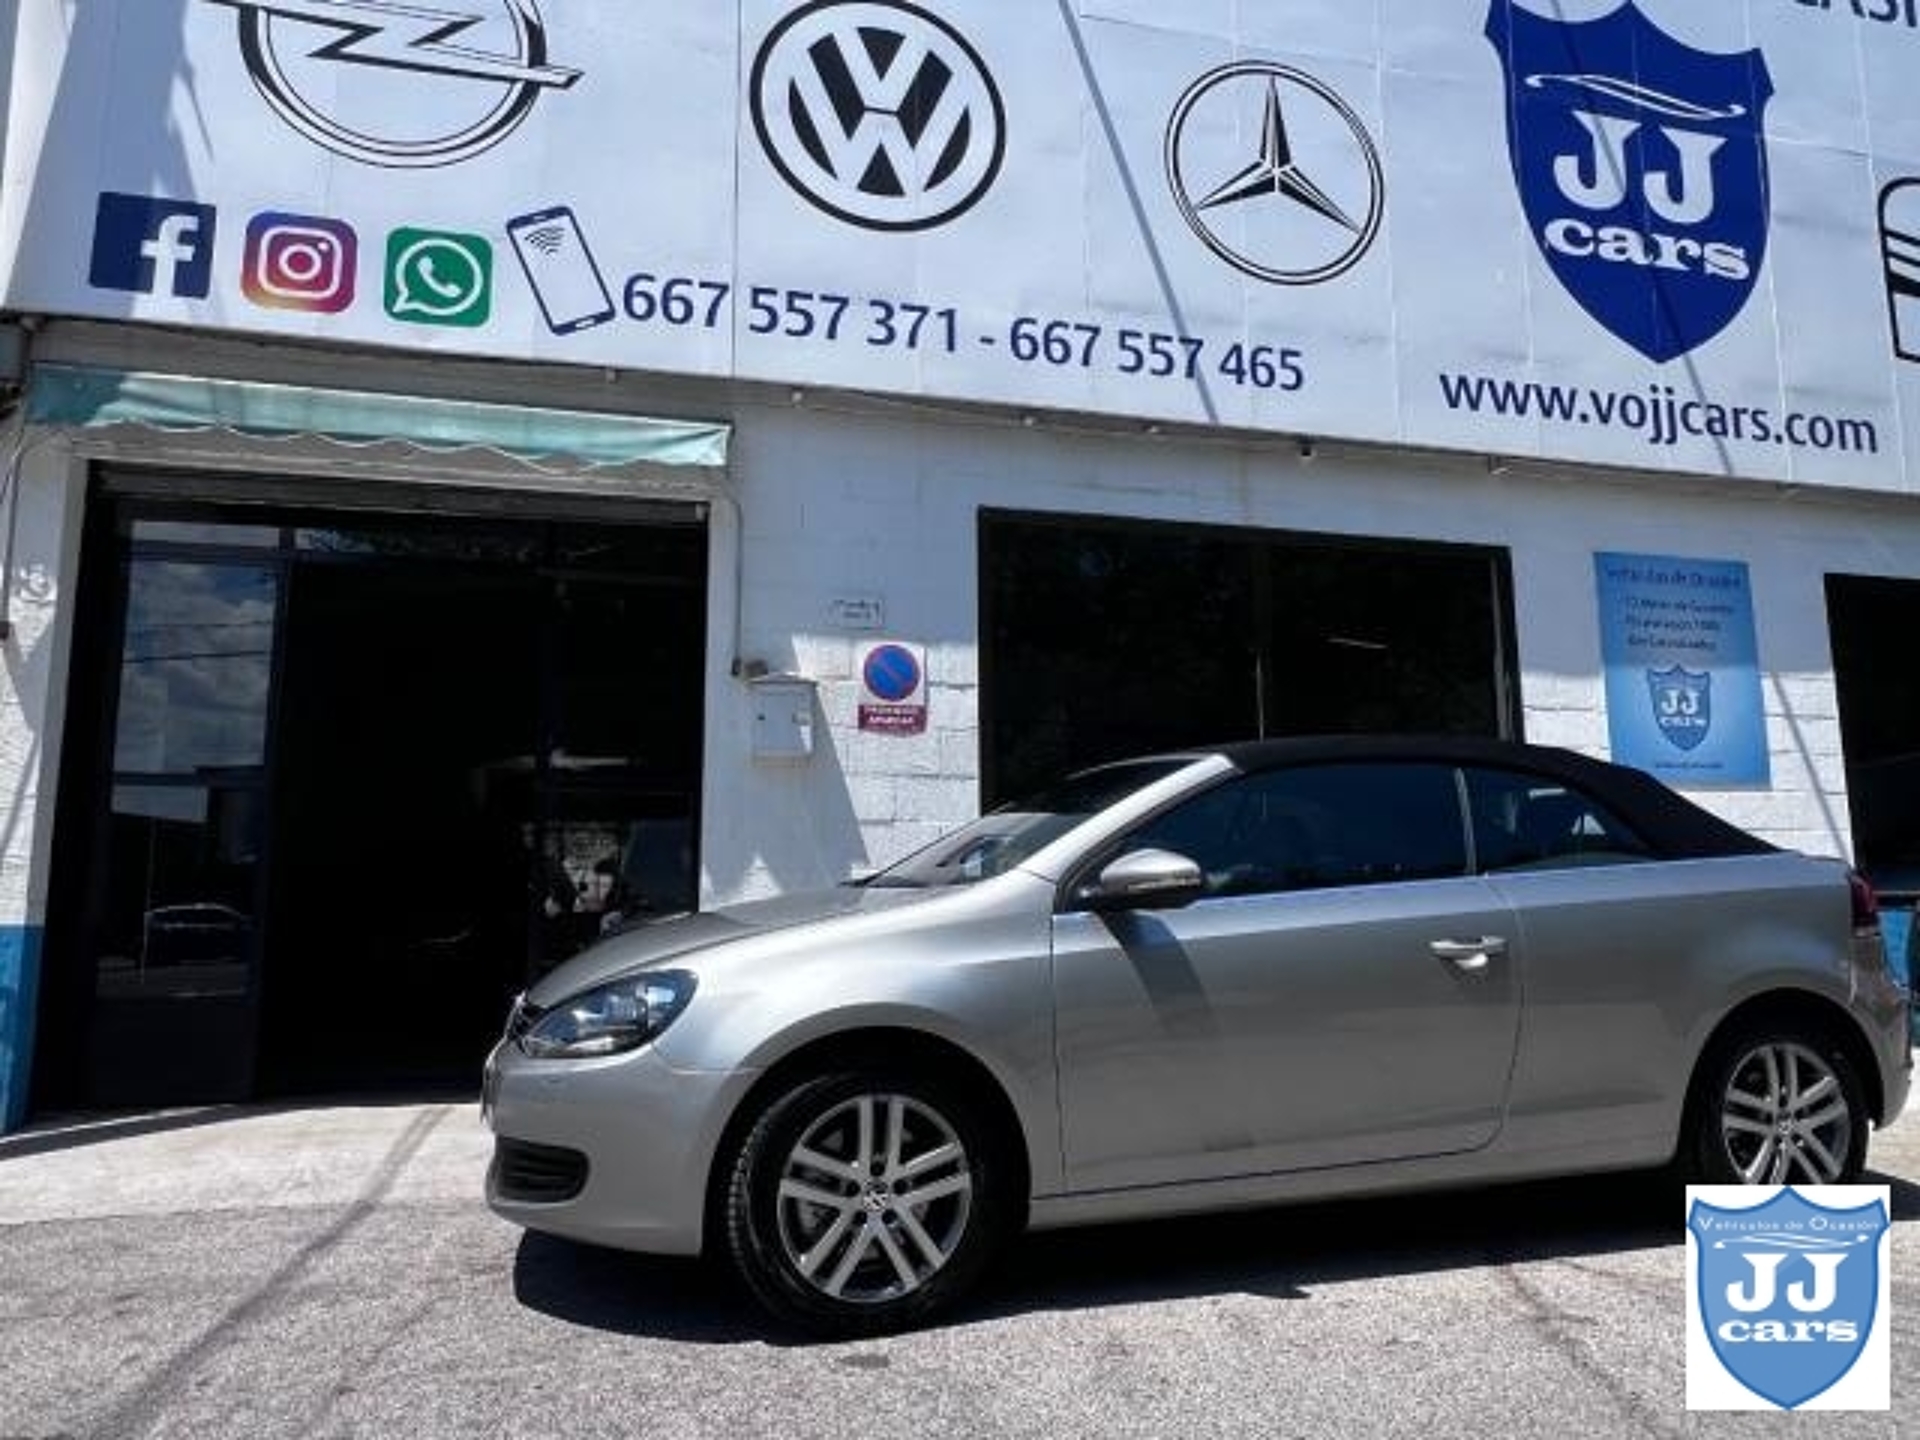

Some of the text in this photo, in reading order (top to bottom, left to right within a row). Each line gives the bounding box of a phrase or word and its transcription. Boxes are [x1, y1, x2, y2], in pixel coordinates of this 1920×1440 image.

[1552, 109, 1729, 225] JJ
[1544, 218, 1750, 280] cars
[623, 272, 730, 327] 667
[748, 286, 850, 341] 557
[866, 299, 956, 353] 371
[1009, 317, 1101, 367] 667
[1116, 329, 1204, 380] 557
[1217, 342, 1305, 392] 465
[1438, 373, 1879, 454] www.vojjcars.com
[1661, 688, 1700, 715] JJ
